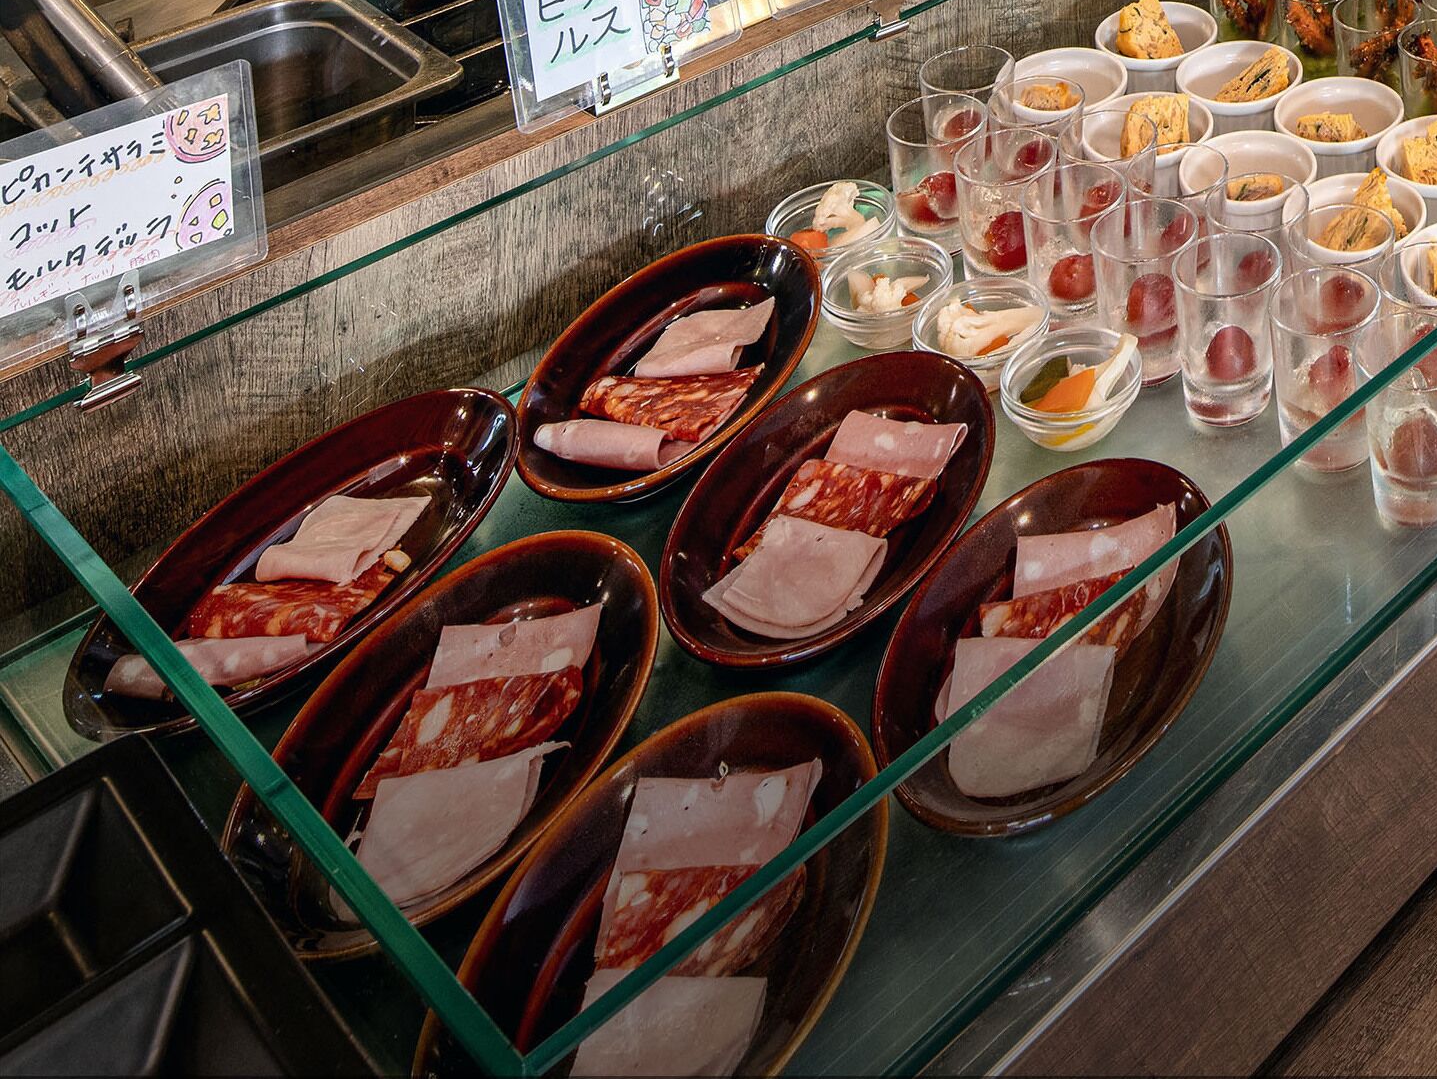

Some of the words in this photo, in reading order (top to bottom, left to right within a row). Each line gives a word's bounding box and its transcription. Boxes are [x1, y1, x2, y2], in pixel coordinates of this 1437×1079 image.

[550, 6, 631, 64] ルス
[1, 129, 166, 205] ピカンテサラミ
[5, 215, 172, 291] モルタデッラ
[9, 204, 92, 250] コット
